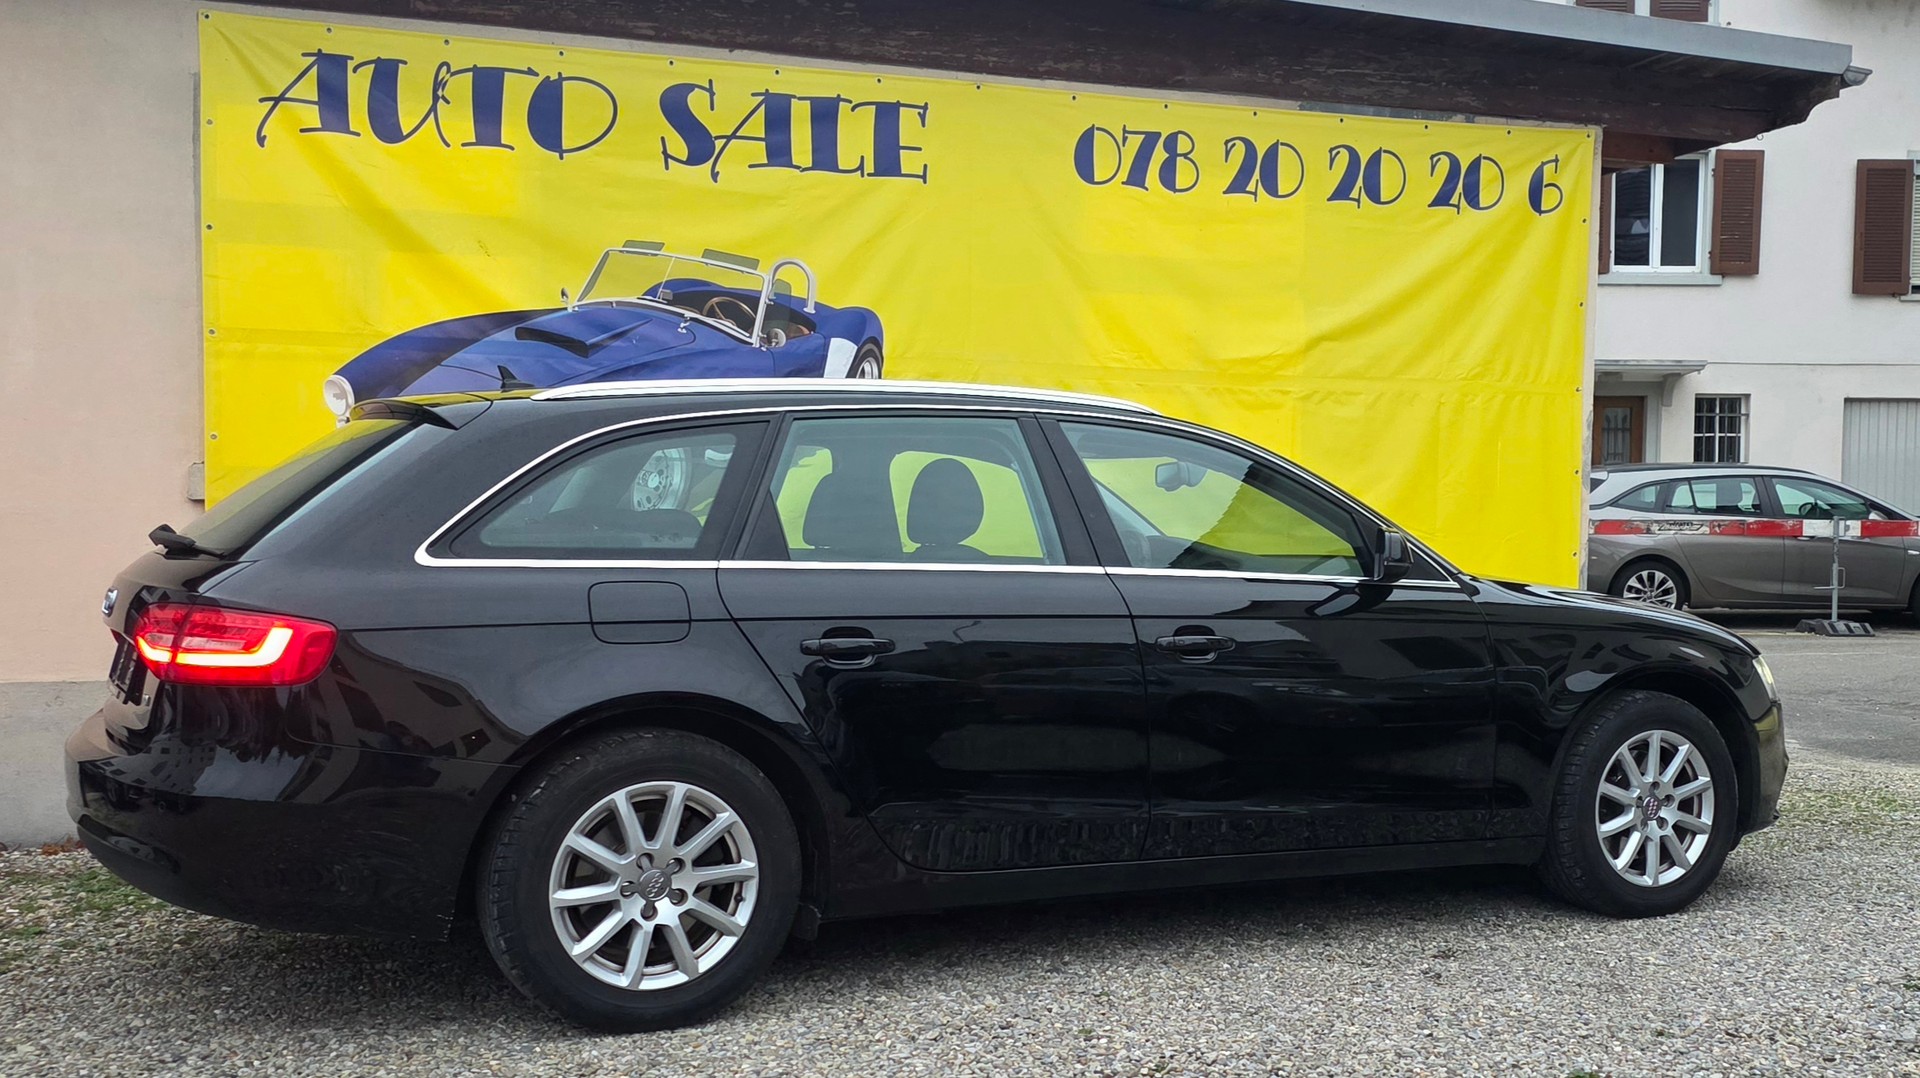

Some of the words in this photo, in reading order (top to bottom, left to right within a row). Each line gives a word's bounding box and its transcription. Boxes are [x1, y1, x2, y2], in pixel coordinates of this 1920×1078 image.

[257, 48, 618, 160] AUTO
[659, 79, 929, 184] SALE
[1073, 123, 1200, 194] 078
[1222, 137, 1305, 202] 20
[1326, 145, 1407, 209] 20
[1427, 152, 1505, 215] 20
[1528, 154, 1564, 217] 6
